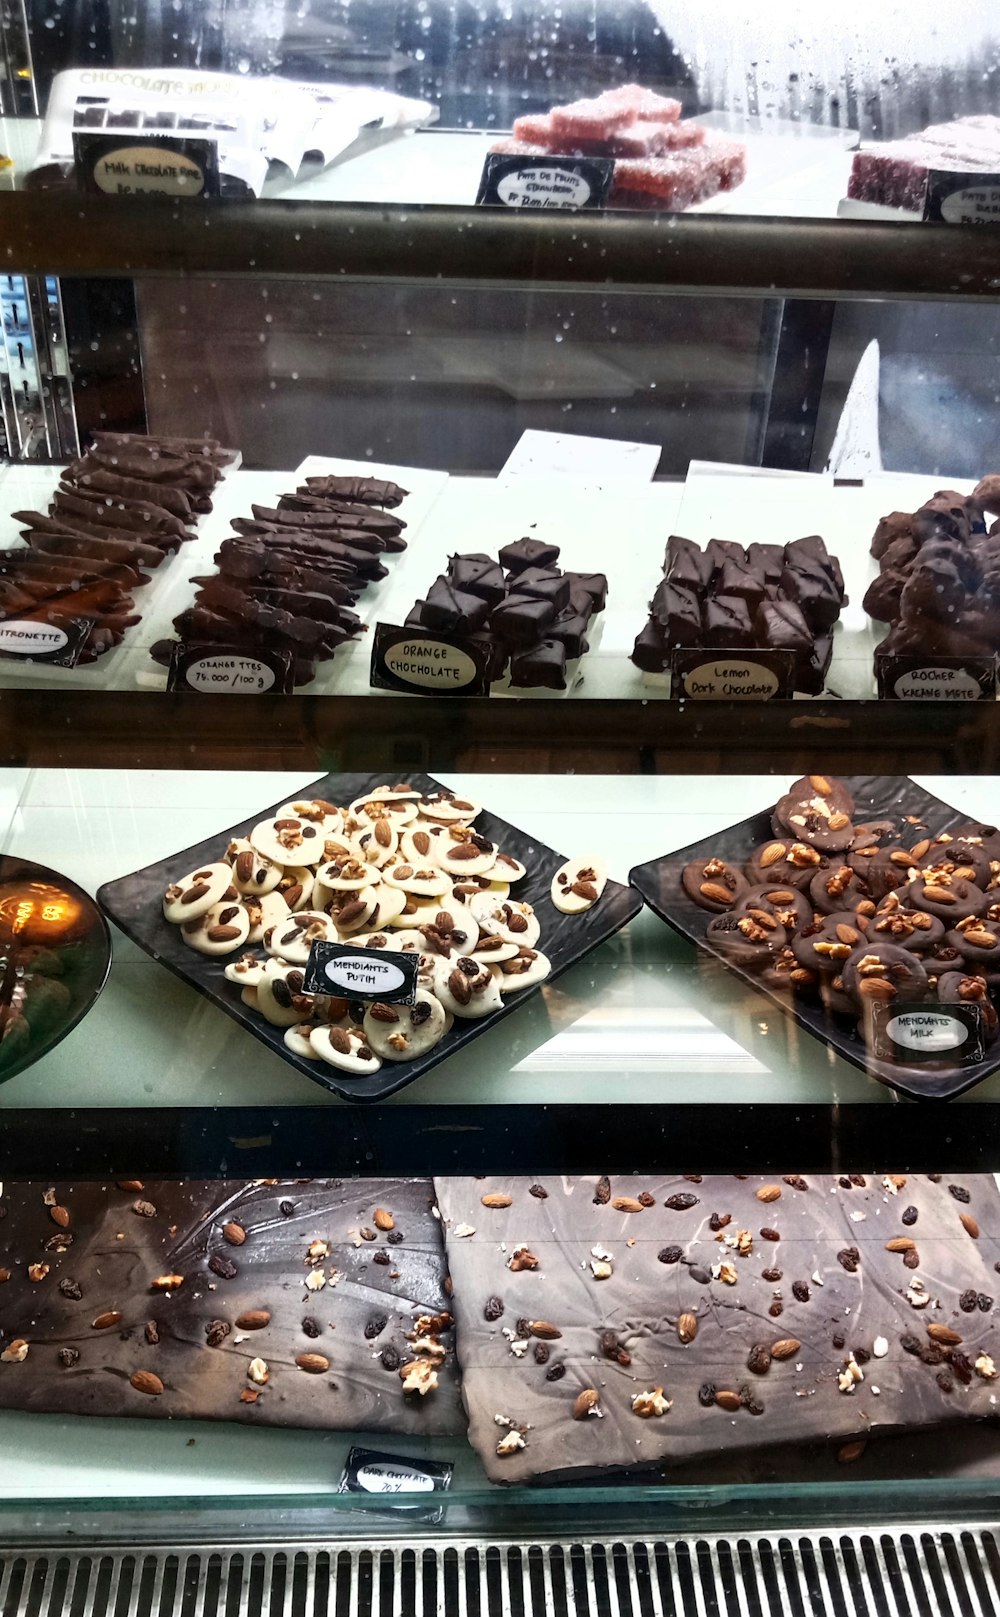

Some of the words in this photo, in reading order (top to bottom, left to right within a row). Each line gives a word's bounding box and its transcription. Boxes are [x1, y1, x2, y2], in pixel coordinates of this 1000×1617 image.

[403, 644, 447, 660] ORANGE
[390, 660, 460, 680] CHOCHOLATE
[714, 667, 750, 679] Lemon
[691, 682, 716, 694] Dark
[722, 683, 773, 696] Chocolate
[346, 971, 377, 985] PUTIH
[910, 1028, 934, 1038] MILK
[363, 1466, 384, 1477] DARK
